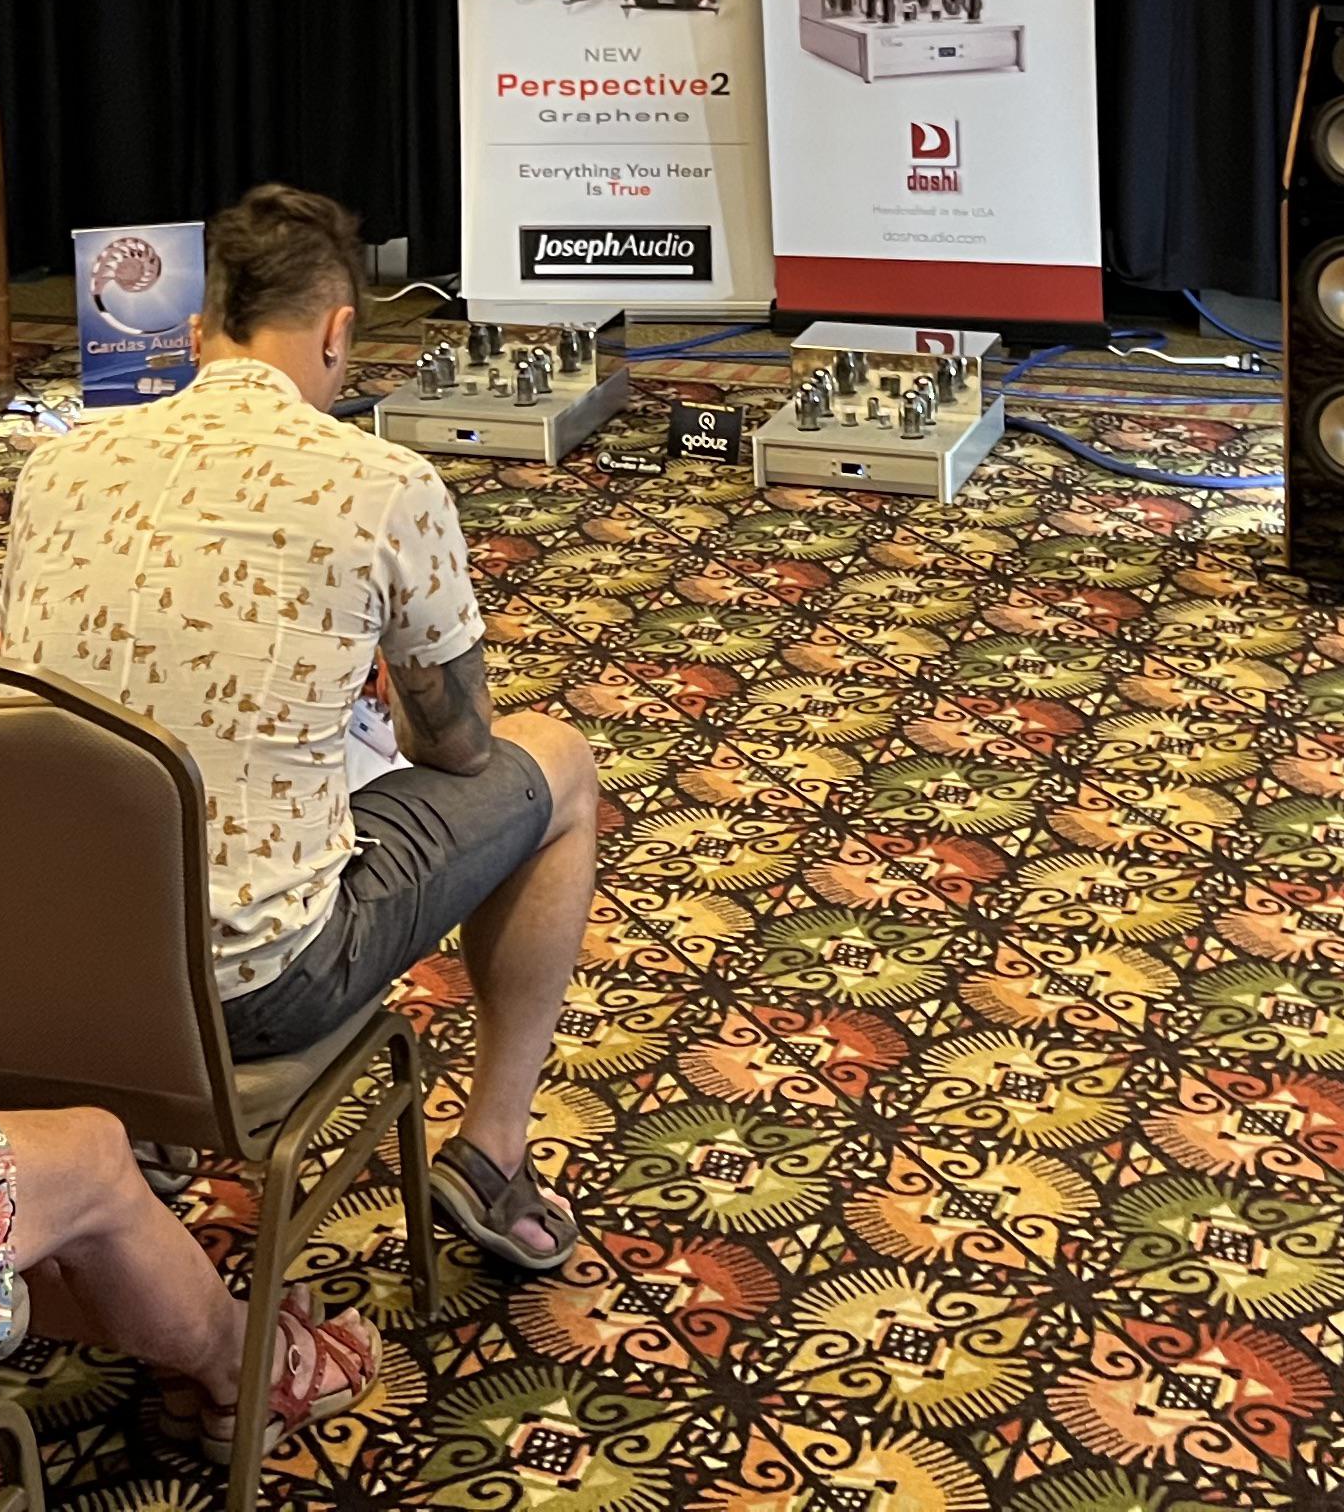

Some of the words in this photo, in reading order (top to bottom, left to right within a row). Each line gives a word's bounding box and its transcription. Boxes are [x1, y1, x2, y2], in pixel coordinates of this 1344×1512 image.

[584, 47, 642, 63] NEW
[497, 72, 730, 101] Perspective2
[538, 109, 690, 125] Graphene
[519, 164, 621, 180] Everything
[626, 164, 662, 178] You
[666, 164, 713, 178] Hear
[586, 182, 603, 196] Is
[608, 181, 652, 196] True
[87, 339, 146, 355] Cardas
[151, 335, 192, 350] Audi
[681, 431, 728, 451] qobuz
